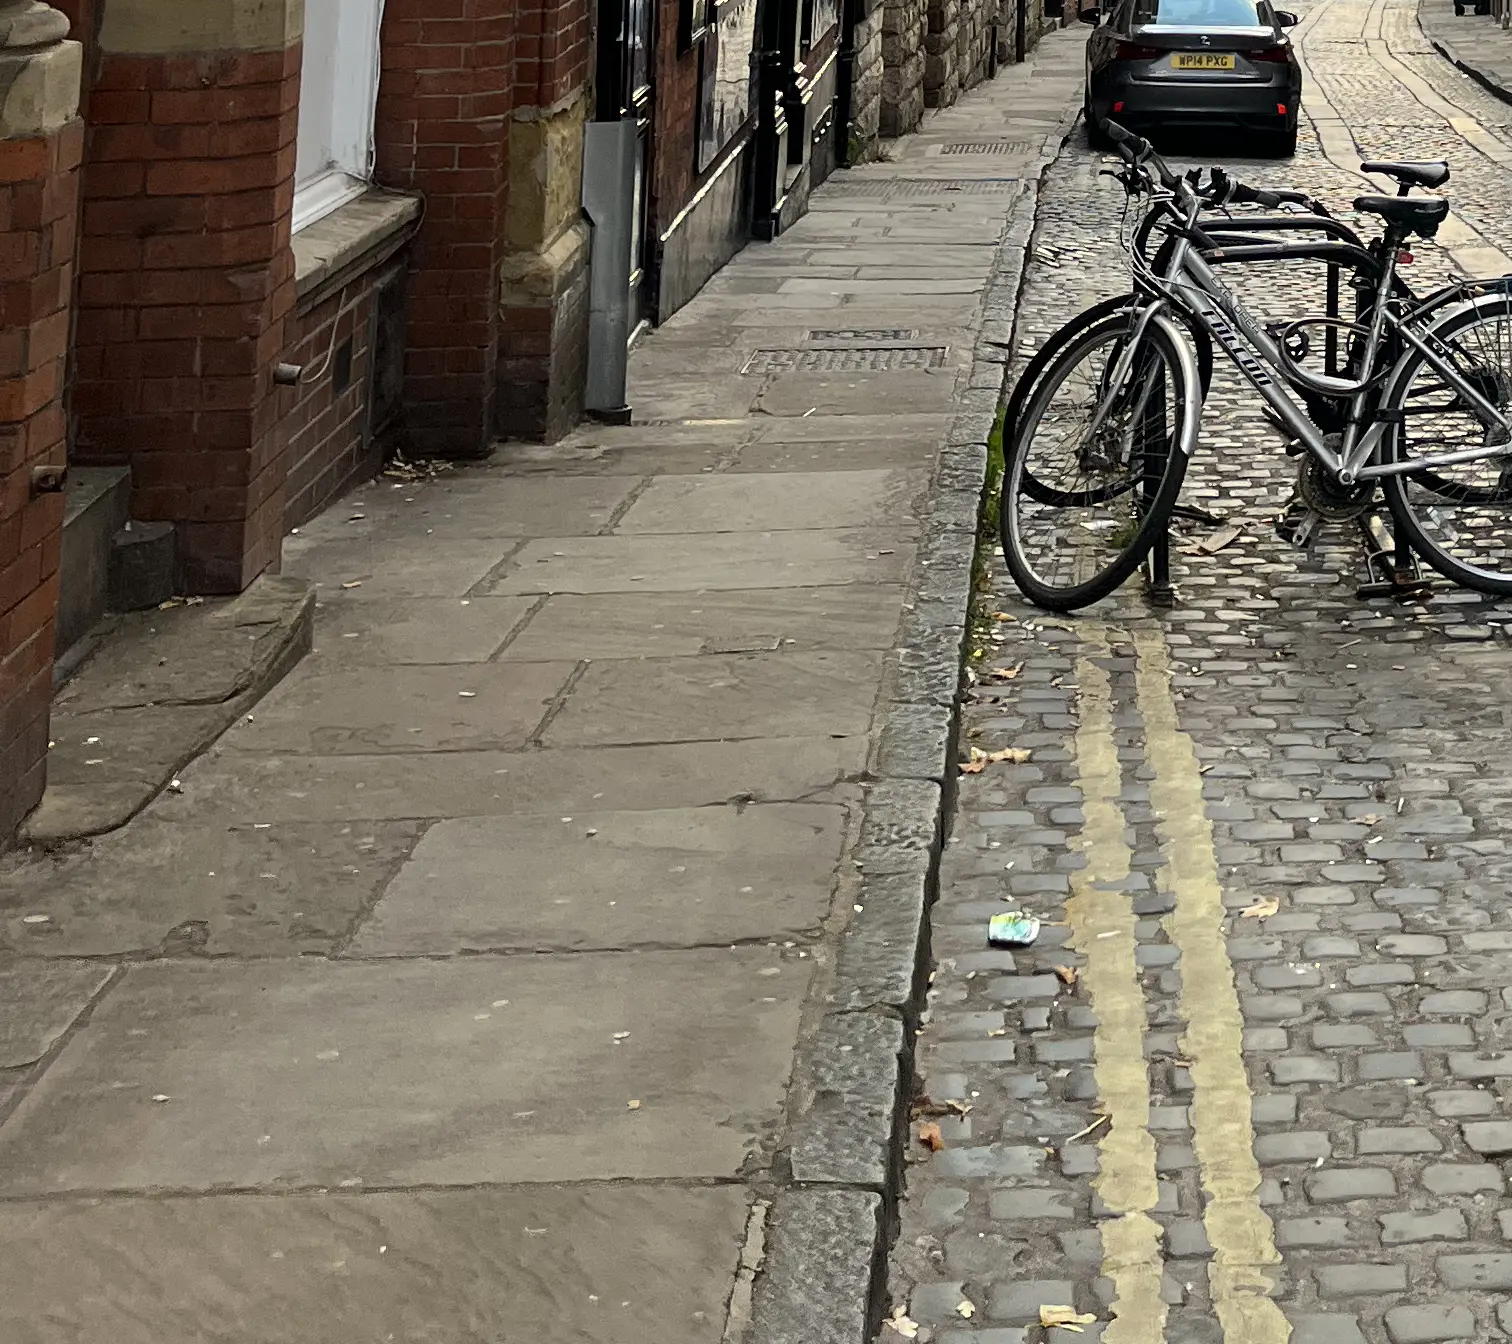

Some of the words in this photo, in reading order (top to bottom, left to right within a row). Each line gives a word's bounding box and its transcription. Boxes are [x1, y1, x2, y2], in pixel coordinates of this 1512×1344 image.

[1206, 55, 1228, 67] PXG
[1211, 275, 1261, 334] EXPORER
[1201, 310, 1273, 386] FALCON
